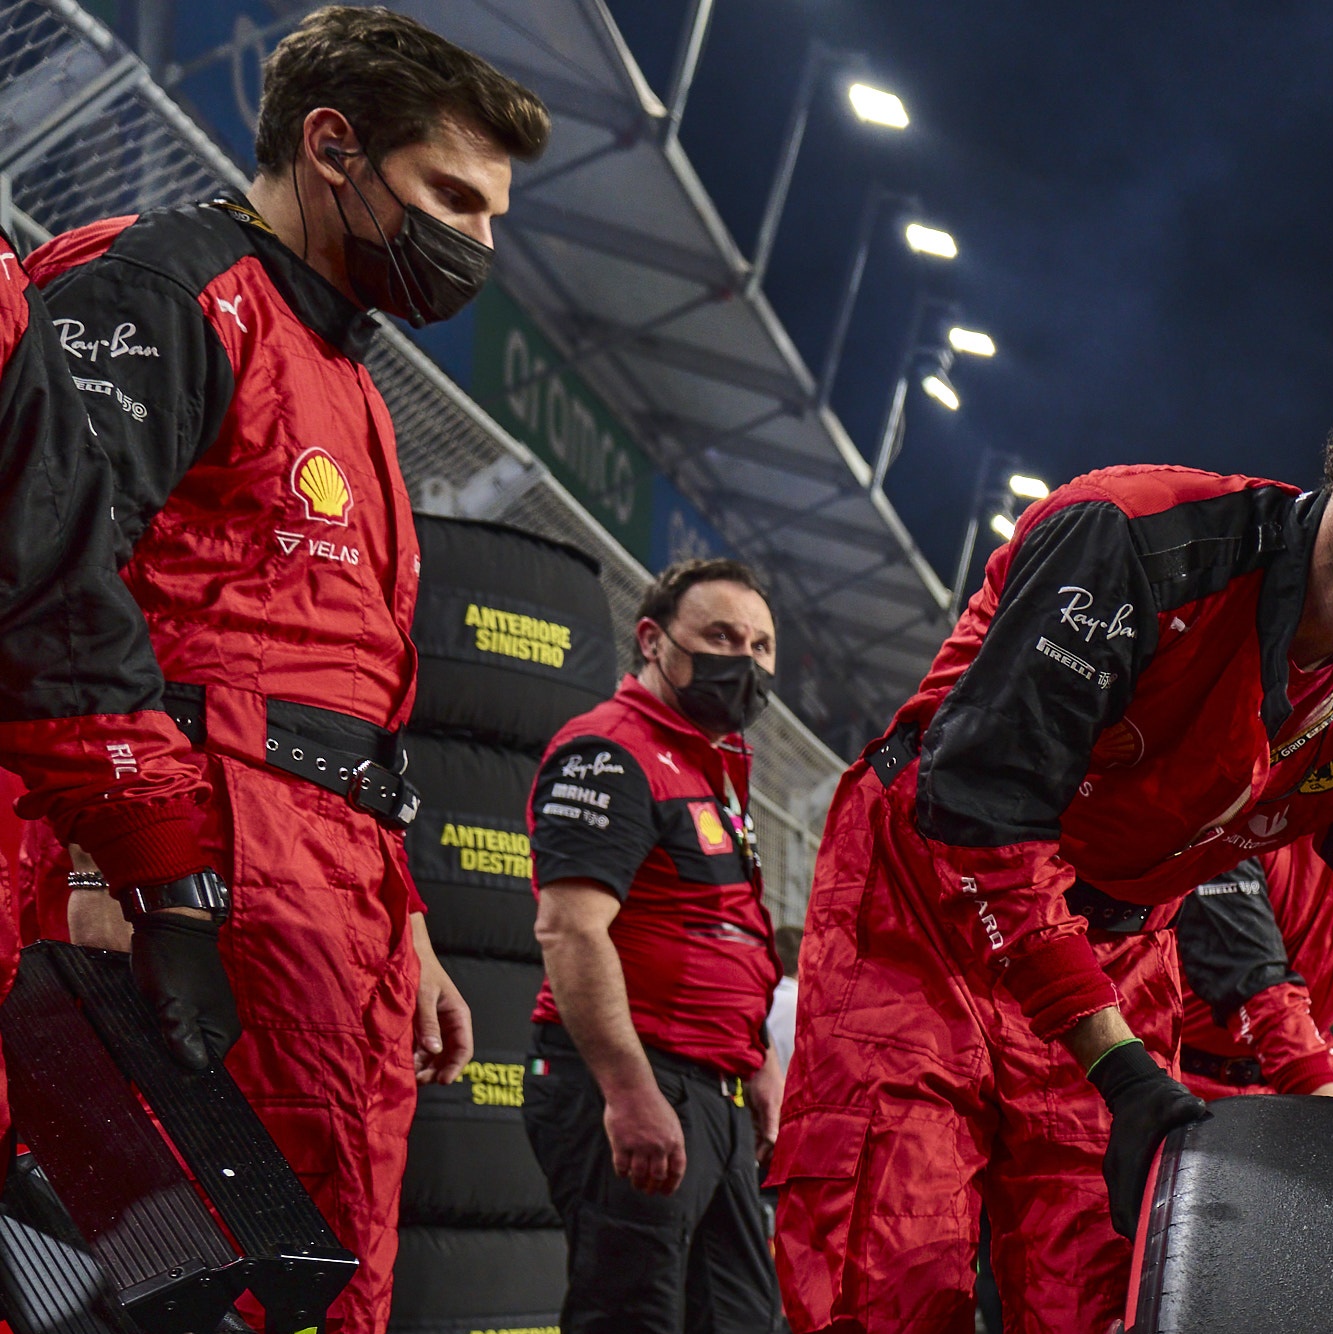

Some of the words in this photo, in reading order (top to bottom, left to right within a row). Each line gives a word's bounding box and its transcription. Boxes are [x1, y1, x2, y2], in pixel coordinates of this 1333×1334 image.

[53, 318, 160, 362] Ray-Ban
[308, 538, 360, 566] VELAS
[465, 603, 572, 650] ANTERIORE
[475, 627, 565, 668] SINISTRO
[1036, 636, 1096, 681] PIRELLI
[1280, 738, 1306, 758] GRID
[560, 751, 626, 780] Ray-Ban
[551, 782, 612, 810] MAHLE
[440, 823, 531, 857] ANTERIO
